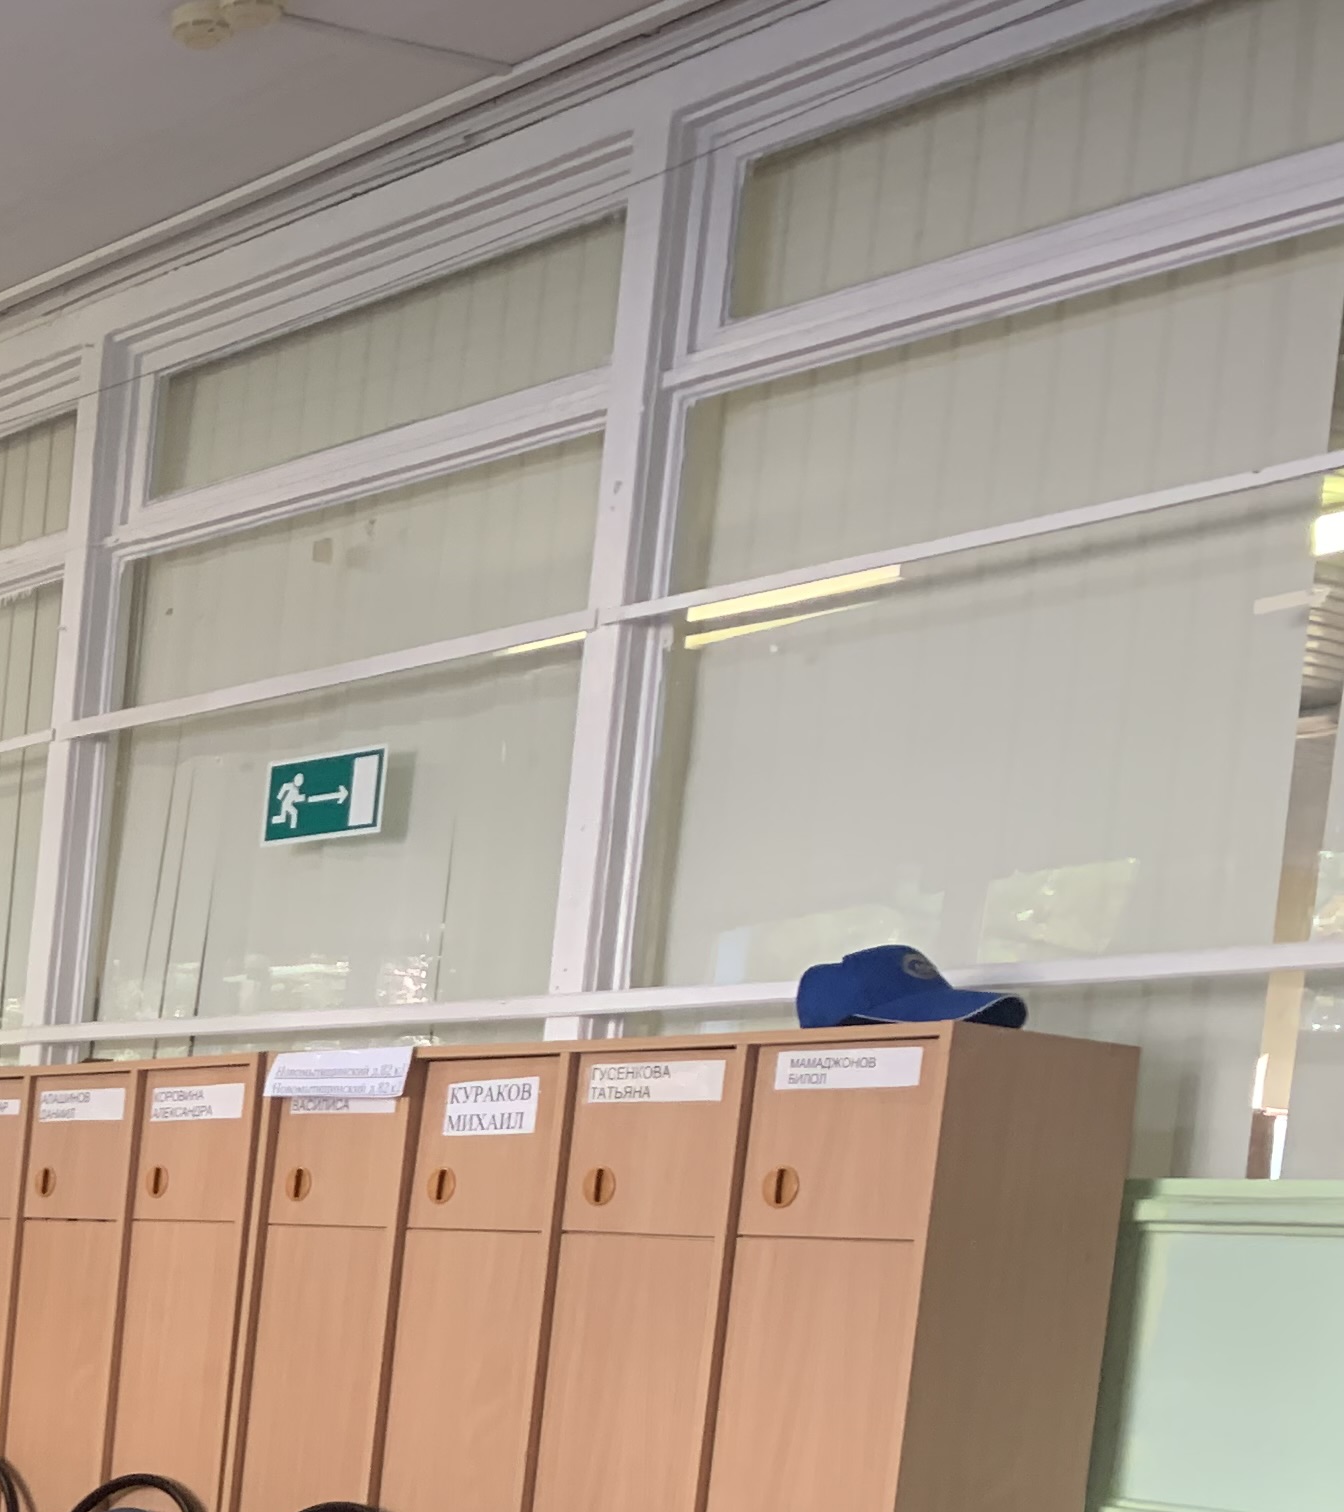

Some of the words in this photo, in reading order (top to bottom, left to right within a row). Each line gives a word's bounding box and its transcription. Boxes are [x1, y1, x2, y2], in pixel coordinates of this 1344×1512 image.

[790, 1056, 877, 1069] МАМАДЖОНОВ
[592, 1065, 671, 1081] ГУСЕНКОВА
[788, 1073, 827, 1084] БИЛОЛ
[450, 1083, 532, 1104] КУРАКОВ
[592, 1086, 651, 1099] ТАТЬЯНА
[447, 1111, 524, 1132] МИХАИЛ
